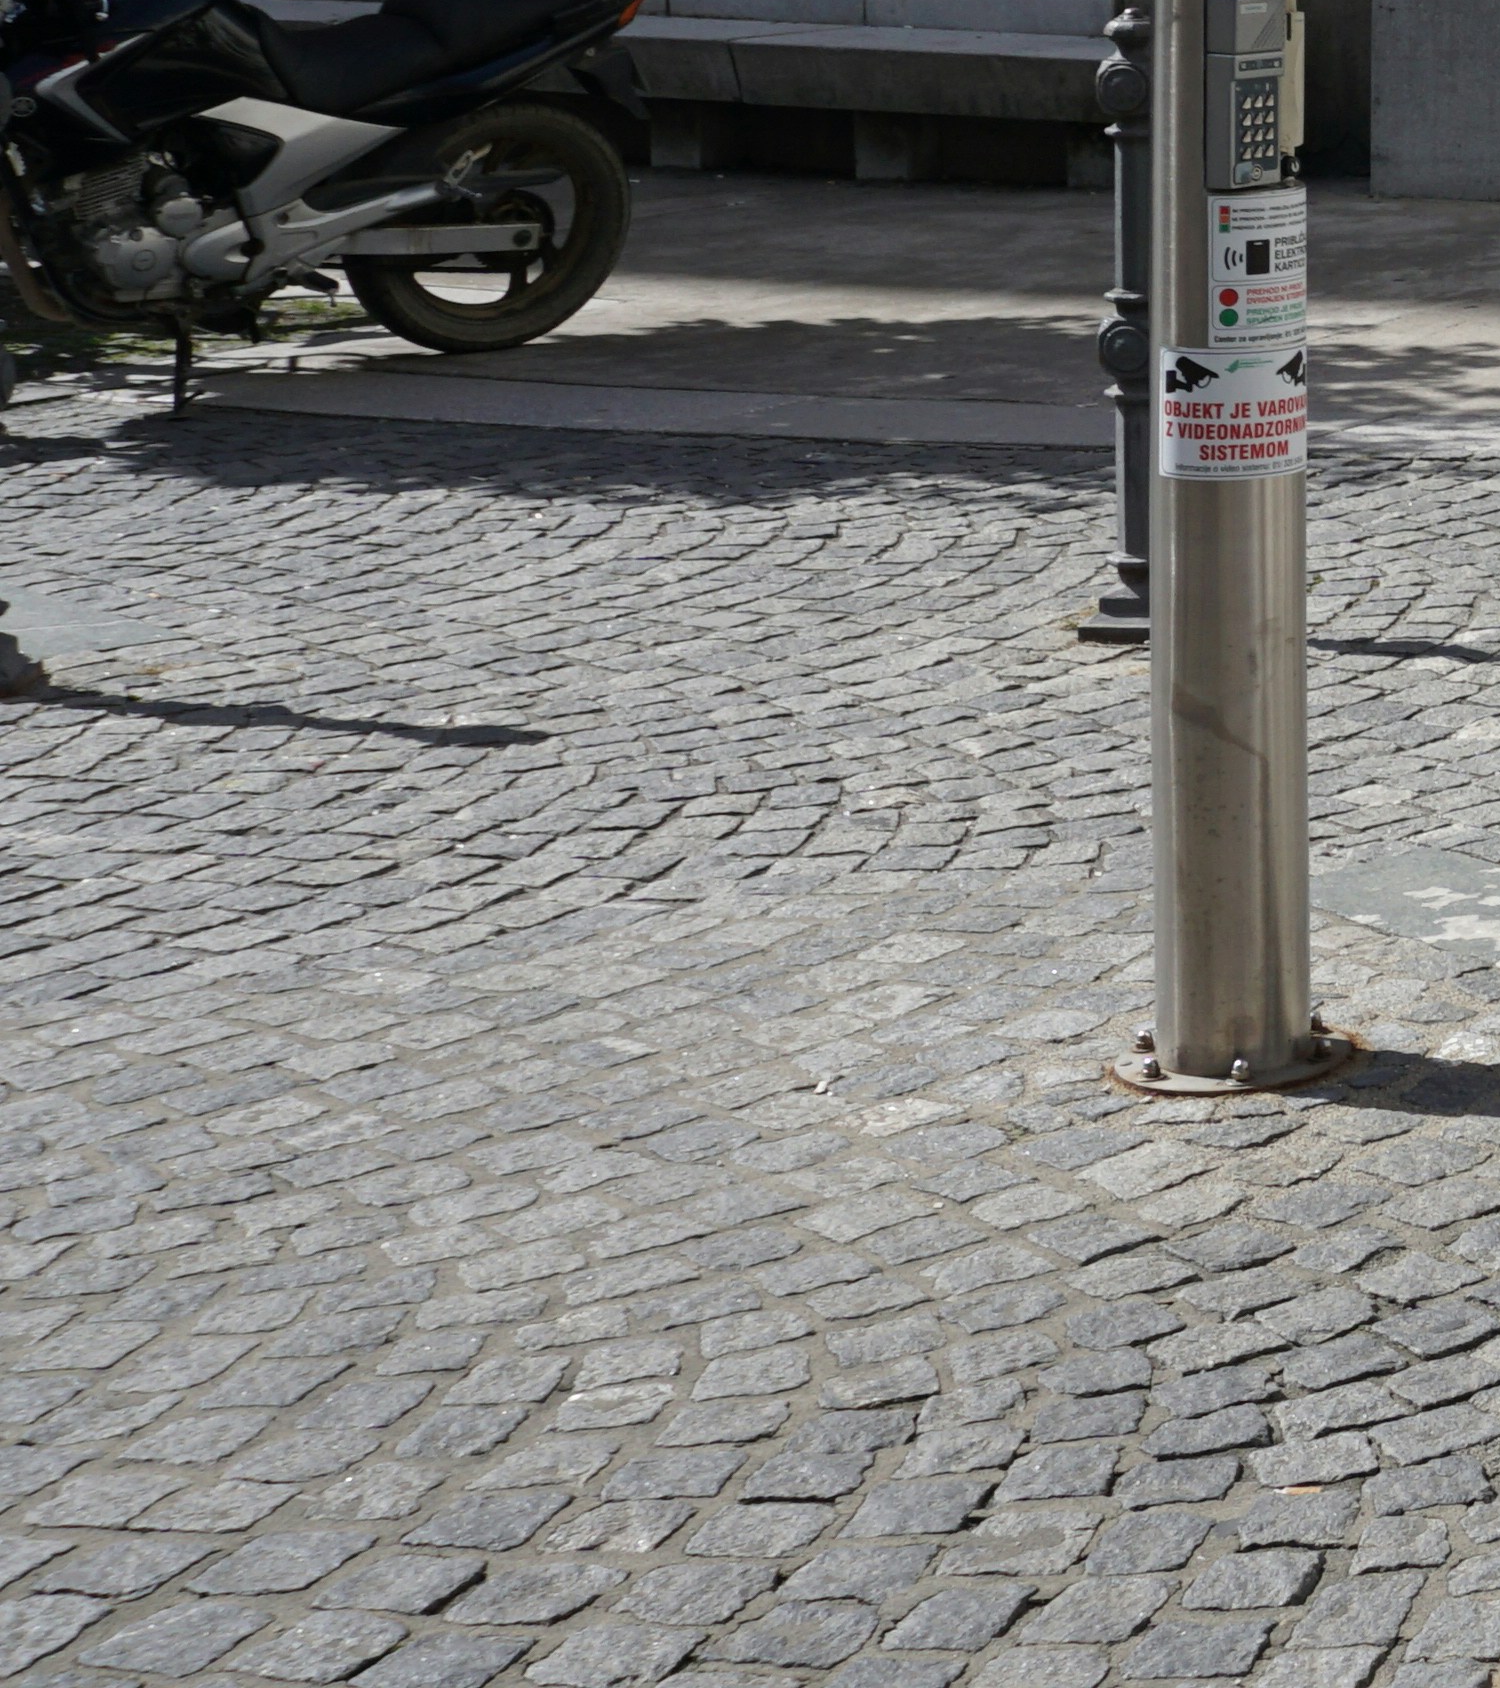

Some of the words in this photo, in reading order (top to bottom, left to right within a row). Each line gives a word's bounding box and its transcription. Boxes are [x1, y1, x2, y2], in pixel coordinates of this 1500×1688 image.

[1165, 400, 1224, 419] OBJEKT
[1230, 402, 1251, 419] JE
[1166, 421, 1174, 437] Z
[1199, 440, 1289, 461] SISTEMOM
